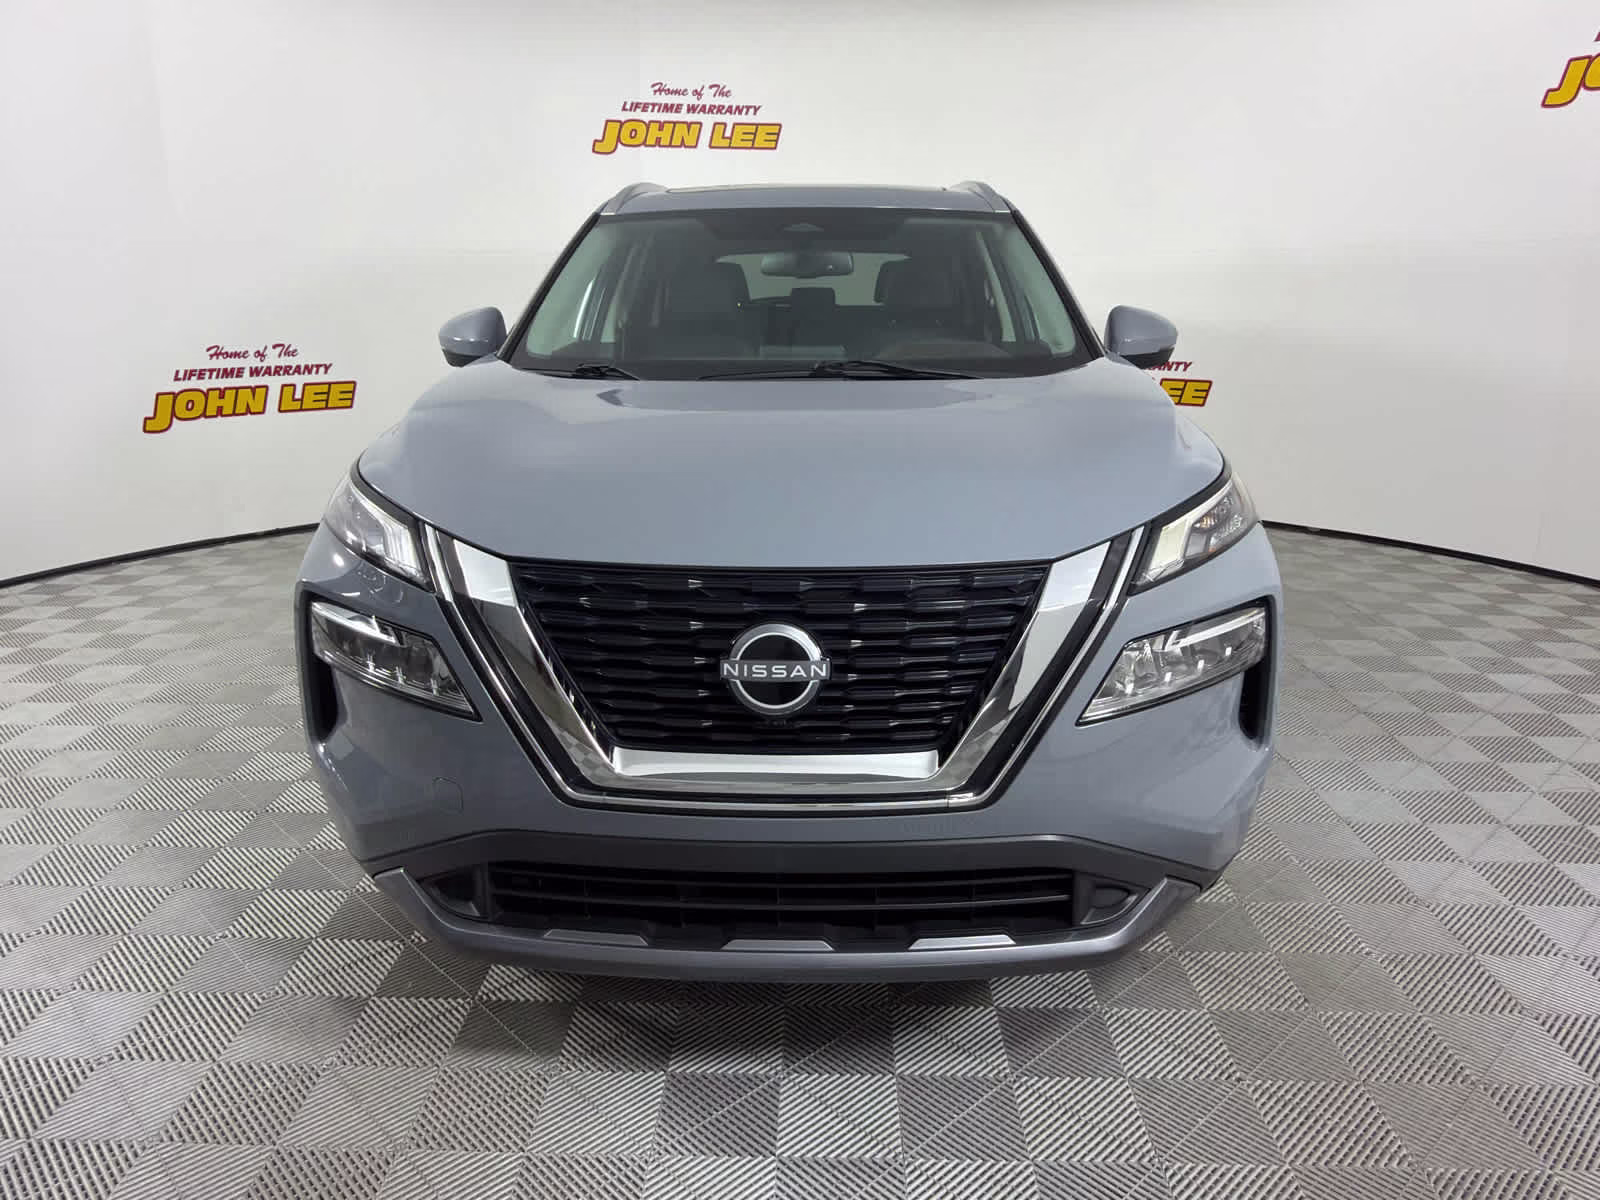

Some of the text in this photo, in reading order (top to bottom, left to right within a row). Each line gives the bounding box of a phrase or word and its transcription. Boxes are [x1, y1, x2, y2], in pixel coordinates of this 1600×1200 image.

[651, 82, 732, 100] Home of The
[622, 101, 761, 115] LIFETIME WARRANTY
[592, 119, 782, 154] JOHN LEE
[206, 343, 298, 361] Home of The
[173, 363, 332, 381] LIFETIME WARRANTY
[143, 380, 356, 433] JOHN LEE
[723, 663, 826, 678] NISSAN
